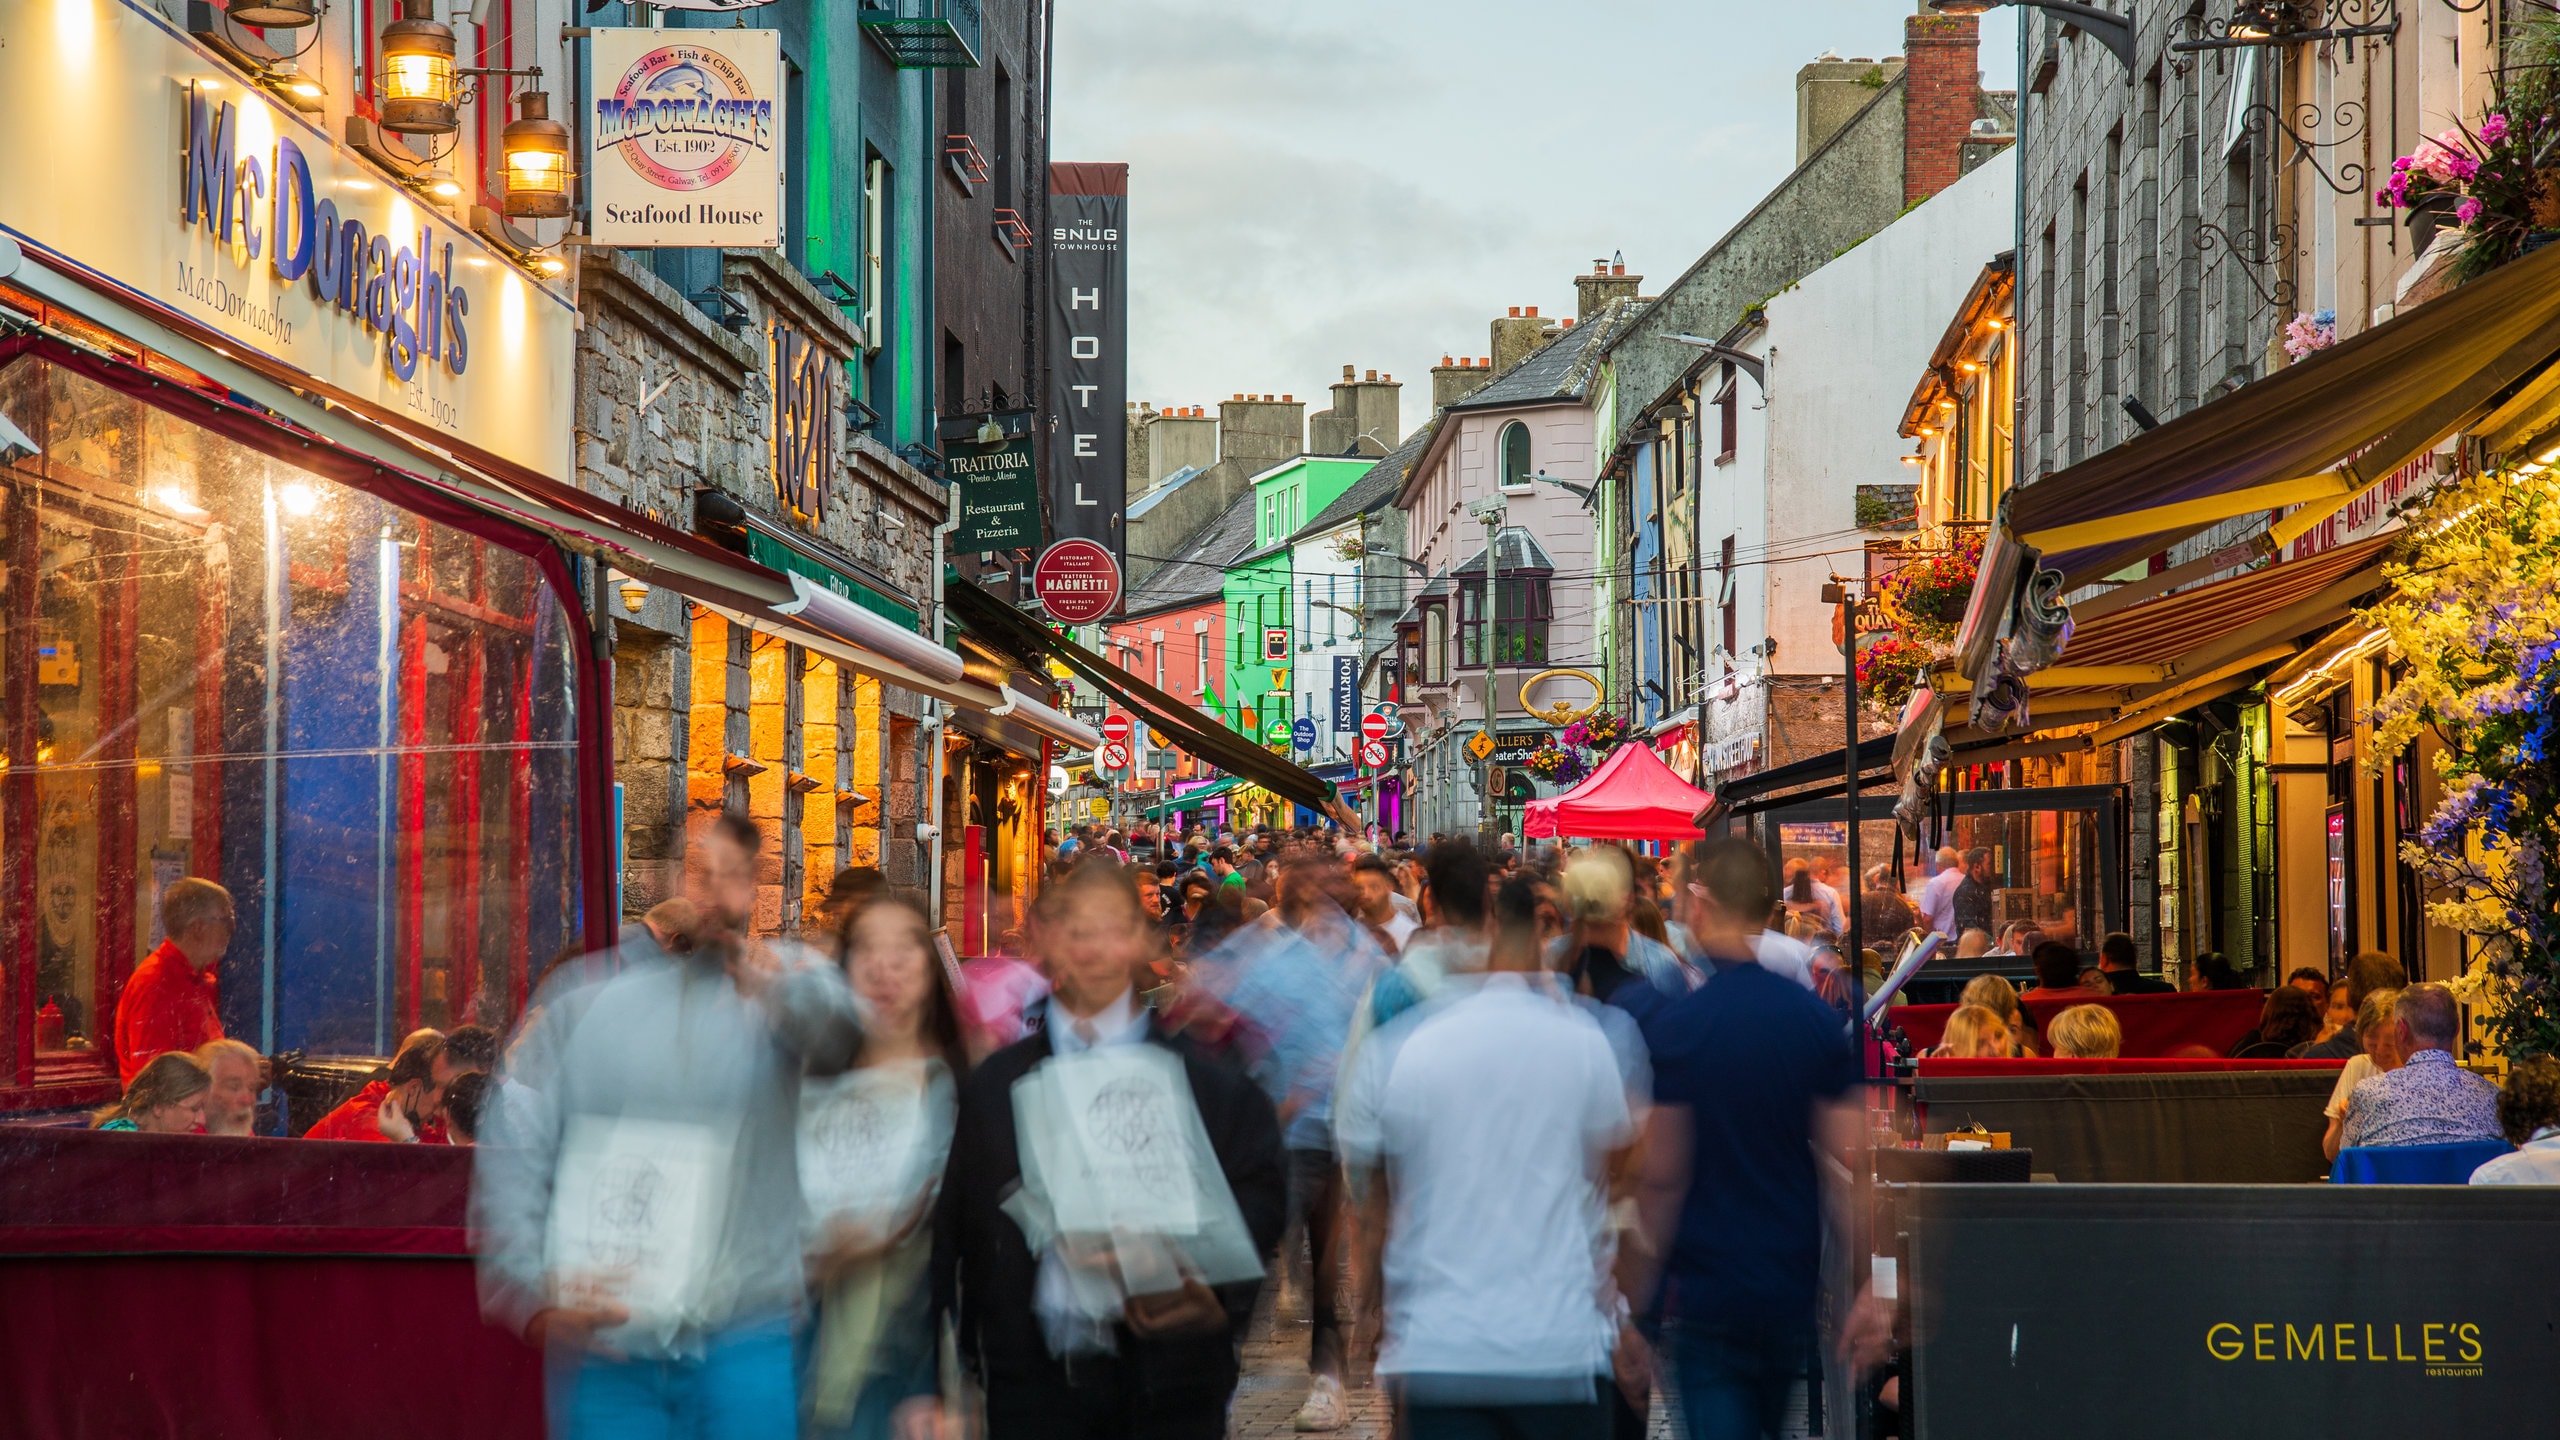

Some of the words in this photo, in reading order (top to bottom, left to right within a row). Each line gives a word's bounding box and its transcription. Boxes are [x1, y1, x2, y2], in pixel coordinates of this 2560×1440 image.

[619, 62, 650, 97] Seafood
[649, 53, 668, 67] Bar
[678, 50, 699, 60] Fish
[701, 53, 711, 63] &
[712, 57, 735, 79] Chip
[733, 75, 748, 96] Bar
[655, 139, 681, 153] Est.
[684, 139, 715, 153] 1902
[624, 142, 634, 153] 22
[630, 152, 646, 171] Quay
[645, 167, 666, 183] Street,
[699, 174, 710, 183] Tel.
[710, 165, 725, 177] 091
[724, 143, 743, 166] 565001
[606, 203, 690, 224] Seafood
[700, 204, 763, 225] House
[1053, 228, 1118, 241] SNUG
[1053, 243, 1118, 251] TOWNHOUSE
[177, 260, 292, 346] MacDonnacha
[1071, 287, 1099, 506] HOTEL
[408, 381, 427, 412] Est.
[431, 397, 458, 430] 1902
[950, 452, 1029, 474] TRATTORIA
[965, 502, 1025, 516] Restaurant
[991, 515, 1001, 526] &
[976, 527, 1019, 539] Pizzeria
[1046, 579, 1108, 591] MAGNETTI
[1855, 614, 1893, 632] QUAY
[1496, 735, 1533, 747] ALLER'S
[1495, 752, 1517, 761] eater
[1517, 748, 1533, 761] Sho
[2206, 1322, 2482, 1361] GEMELLE'S
[2425, 1367, 2483, 1377] restaurant
